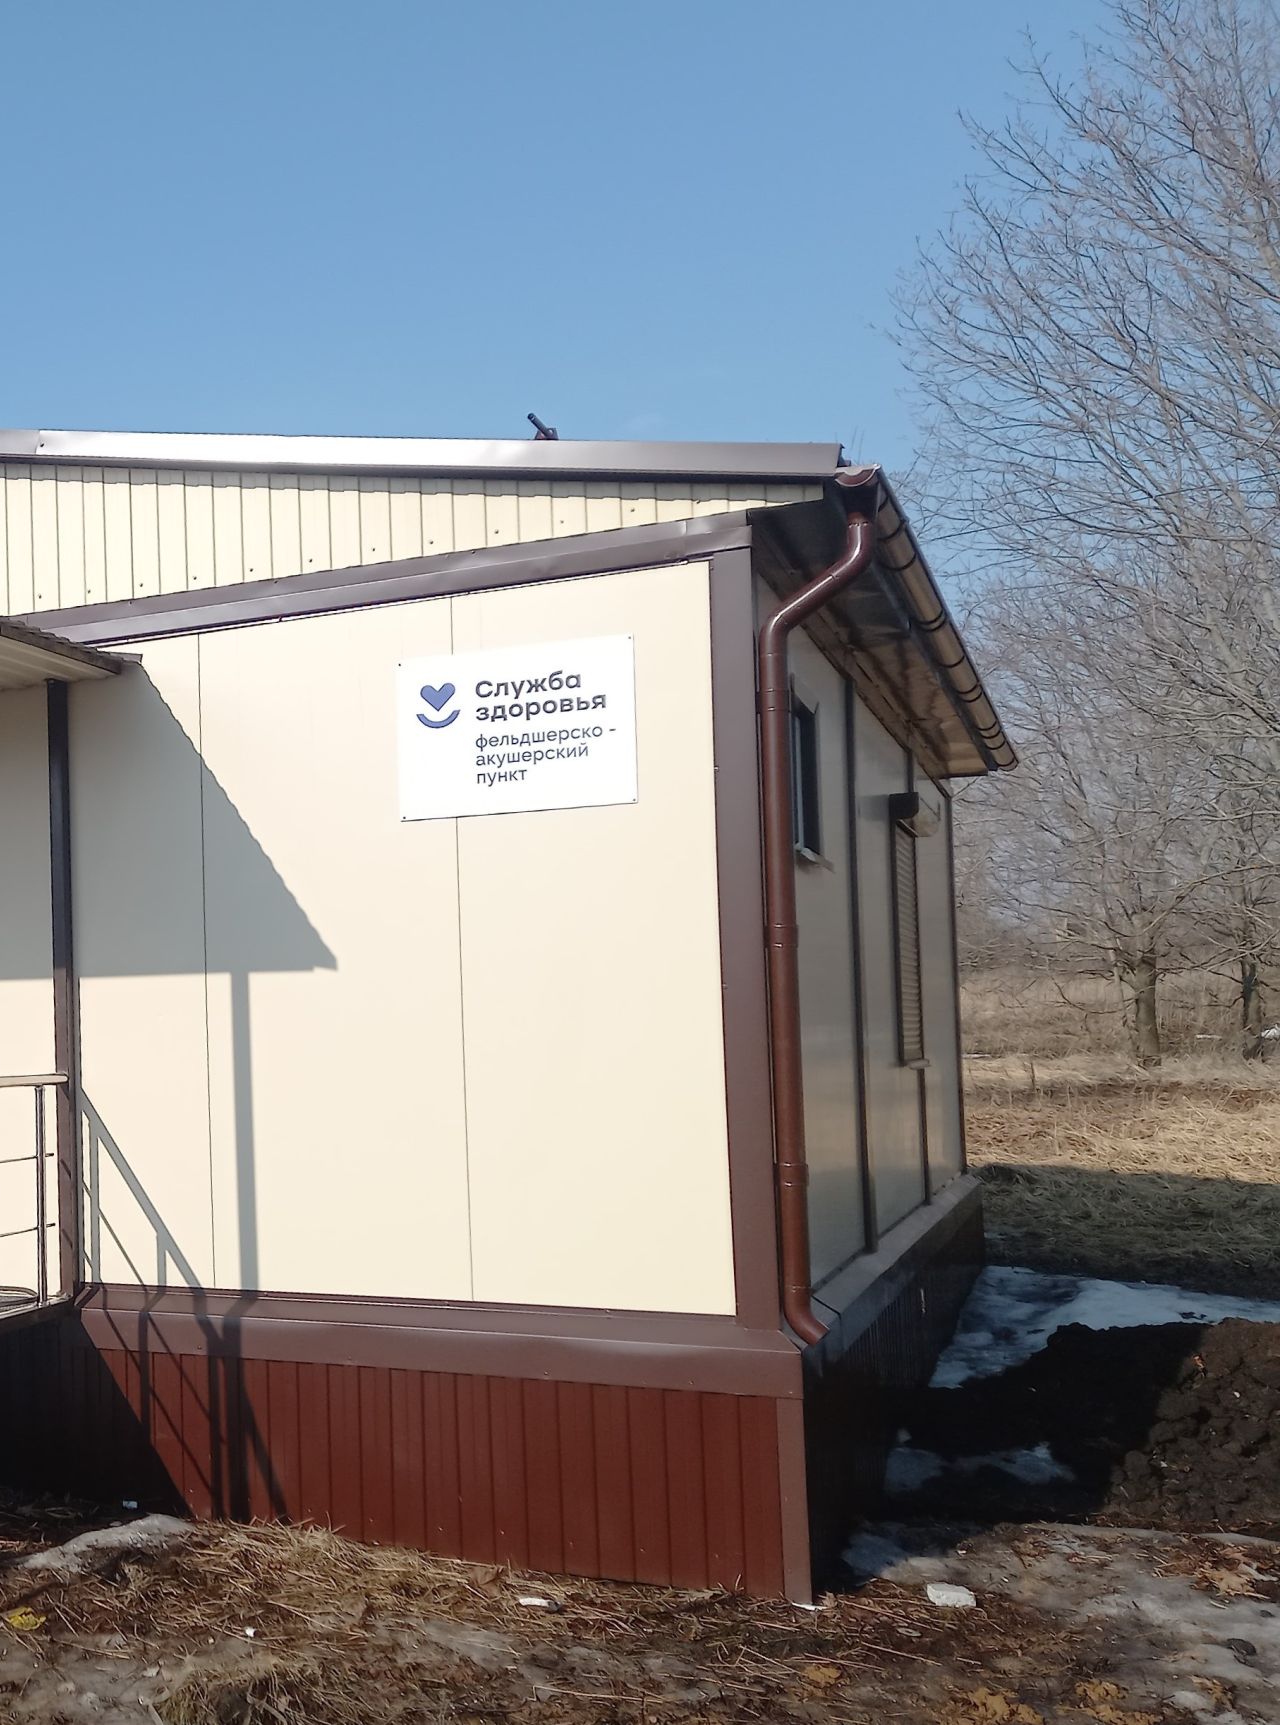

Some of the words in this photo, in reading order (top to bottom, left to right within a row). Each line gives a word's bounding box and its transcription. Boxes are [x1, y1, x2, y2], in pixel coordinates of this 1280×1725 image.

[475, 671, 582, 699] Служба
[475, 694, 607, 722] здоровья
[475, 725, 603, 751] фельдшерско
[475, 743, 589, 768] акушерский
[476, 769, 528, 787] пункт
